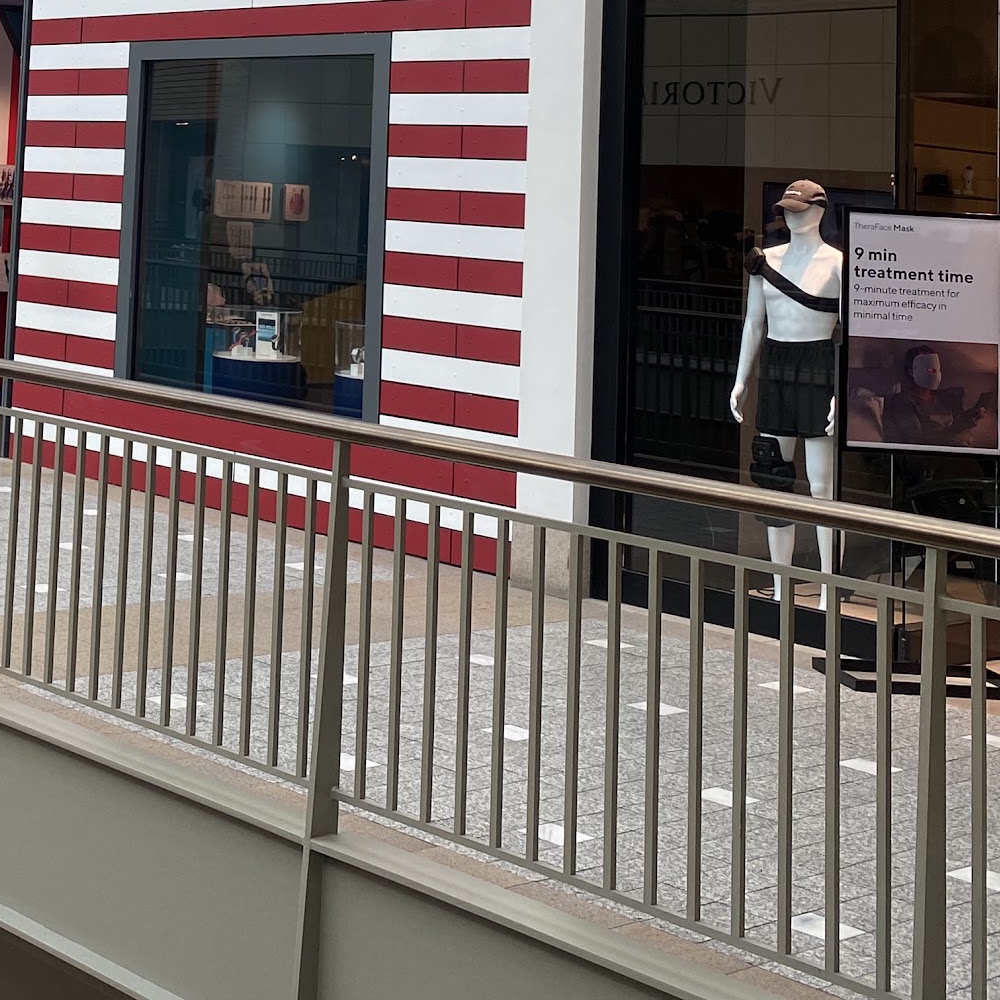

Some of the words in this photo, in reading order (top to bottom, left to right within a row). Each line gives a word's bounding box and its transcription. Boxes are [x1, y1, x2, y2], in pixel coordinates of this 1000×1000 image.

[854, 222, 892, 232] TheraFace
[893, 224, 915, 233] Mask
[854, 246, 865, 260] 9
[868, 248, 897, 262] min
[853, 265, 934, 282] treatment
[938, 269, 974, 284] time
[853, 283, 898, 295] 9-minute
[899, 287, 945, 298] treatment
[947, 288, 960, 298] for
[853, 298, 900, 308] maximum
[901, 300, 937, 312] efficacy
[938, 302, 947, 311] in
[853, 311, 890, 321] minimal
[892, 312, 913, 321] time
